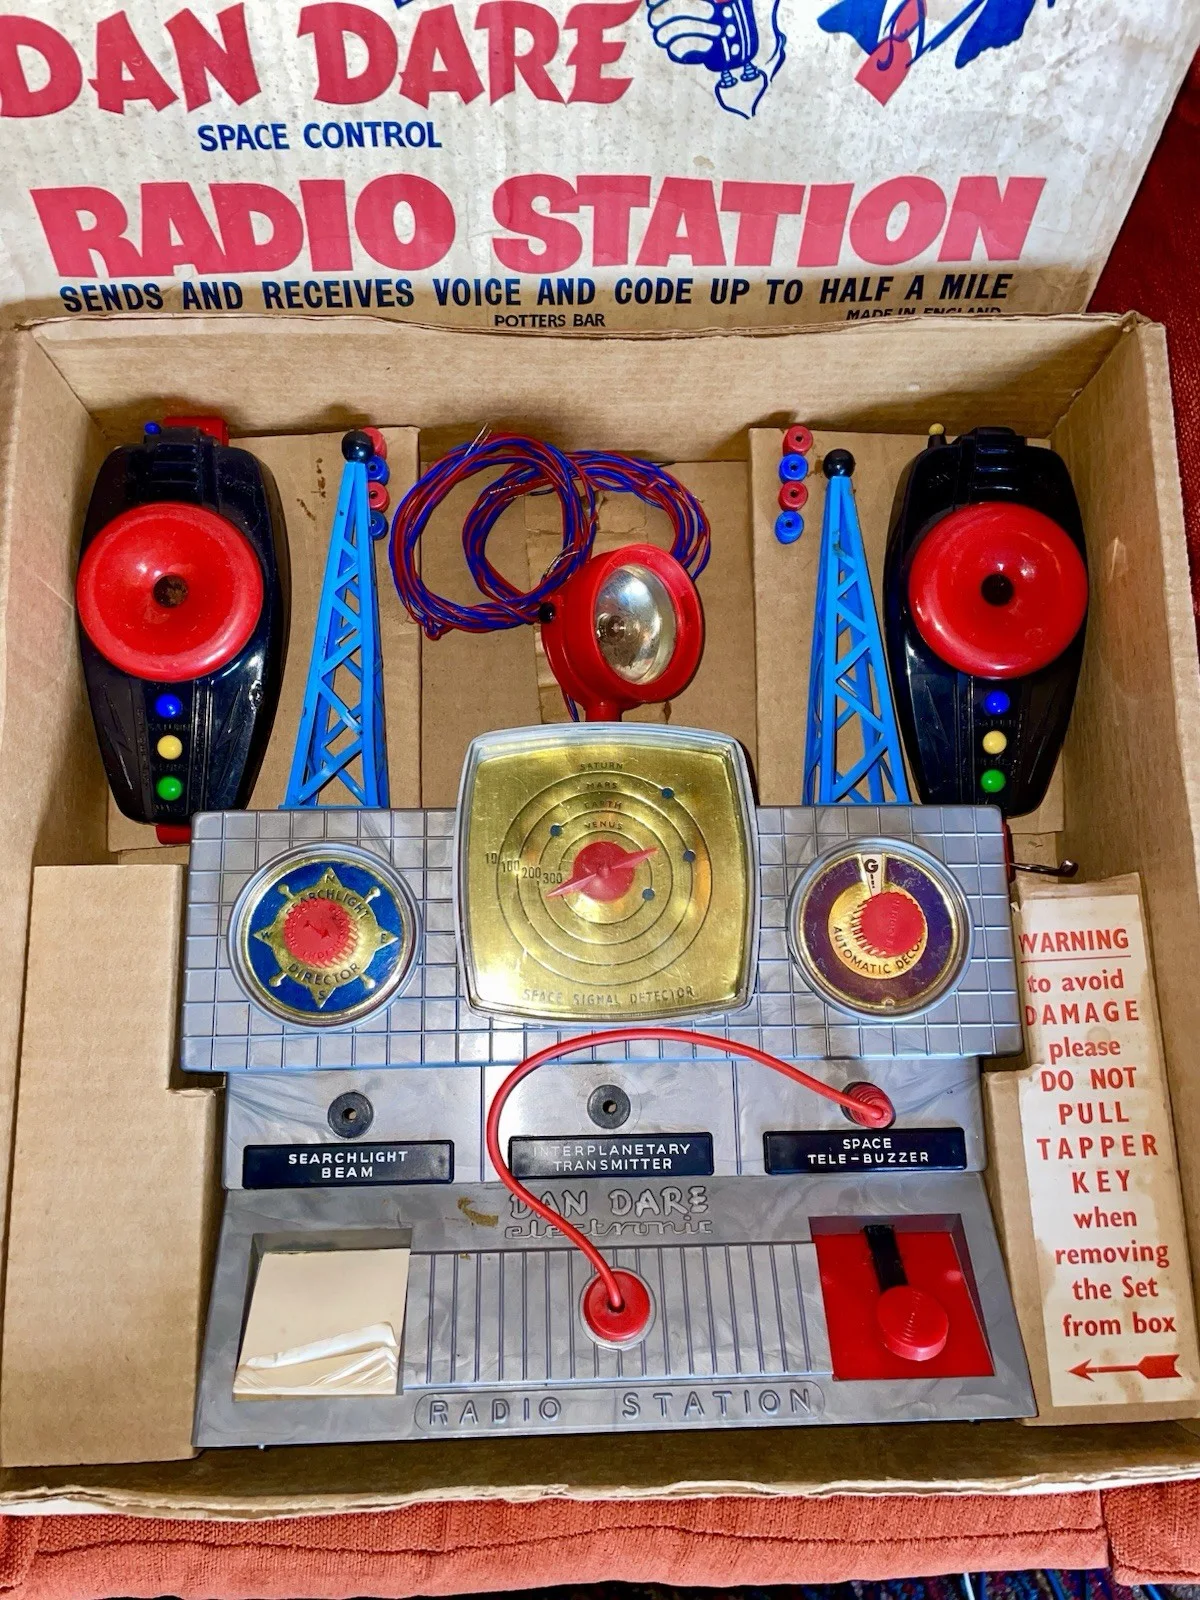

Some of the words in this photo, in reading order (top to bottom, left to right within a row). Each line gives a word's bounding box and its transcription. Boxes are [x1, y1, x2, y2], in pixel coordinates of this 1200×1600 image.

[0, 3, 261, 118] DAN
[297, 0, 643, 108] DARE
[199, 123, 289, 152] SPACE
[303, 121, 442, 149] CONTROL
[30, 173, 456, 278] RADIO
[492, 173, 1048, 274] STATION
[60, 282, 164, 313] SENDS
[182, 281, 243, 310] AND
[267, 278, 415, 309] RECEIVES
[433, 277, 521, 306] VOICE
[537, 277, 596, 306] AND
[615, 277, 692, 305] CODE
[710, 278, 750, 305] UP
[767, 278, 801, 304] TO
[820, 275, 894, 303] HALF
[904, 275, 924, 301] A
[939, 272, 1013, 300] MILE
[494, 313, 566, 328] POTTERS
[573, 313, 606, 328] BAR
[846, 308, 893, 321] MADE
[580, 761, 624, 771] SATURN
[586, 781, 618, 790] MARS
[584, 820, 624, 830] VENUS
[522, 866, 542, 879] 200
[543, 872, 563, 884] 300
[863, 858, 879, 874] G
[833, 926, 892, 975] AUTOMATIC
[1018, 927, 1130, 955] WARNING
[287, 962, 361, 986] DIRECTOR
[1027, 974, 1050, 994] to
[1061, 968, 1125, 992] avoid
[523, 989, 563, 1005] SPACE
[573, 992, 620, 1006] SIGNAL
[629, 986, 695, 1004] DETECTOR
[1025, 1000, 1140, 1026] DAMAGE
[1049, 1037, 1121, 1066] please
[1040, 1069, 1074, 1092] DO
[1090, 1066, 1137, 1090] NOT
[1058, 1101, 1130, 1125] PULL
[533, 1143, 691, 1157] INTERPLANETARY
[843, 1137, 892, 1150] SPACE
[1036, 1134, 1159, 1160] TAPPER
[288, 1150, 409, 1165] SEARCHLIGHT
[554, 1157, 673, 1172] TRANSMITTER
[321, 1166, 374, 1179] BEAM
[1071, 1169, 1130, 1194] KEY
[608, 1185, 709, 1217] DARE
[1073, 1206, 1137, 1229] when
[1055, 1240, 1170, 1268] removing
[1072, 1277, 1112, 1300] the
[1122, 1275, 1159, 1298] Set
[1062, 1314, 1121, 1337] from
[1132, 1312, 1177, 1334] box
[428, 1396, 563, 1427] RADIO
[622, 1388, 812, 1421] STATION
